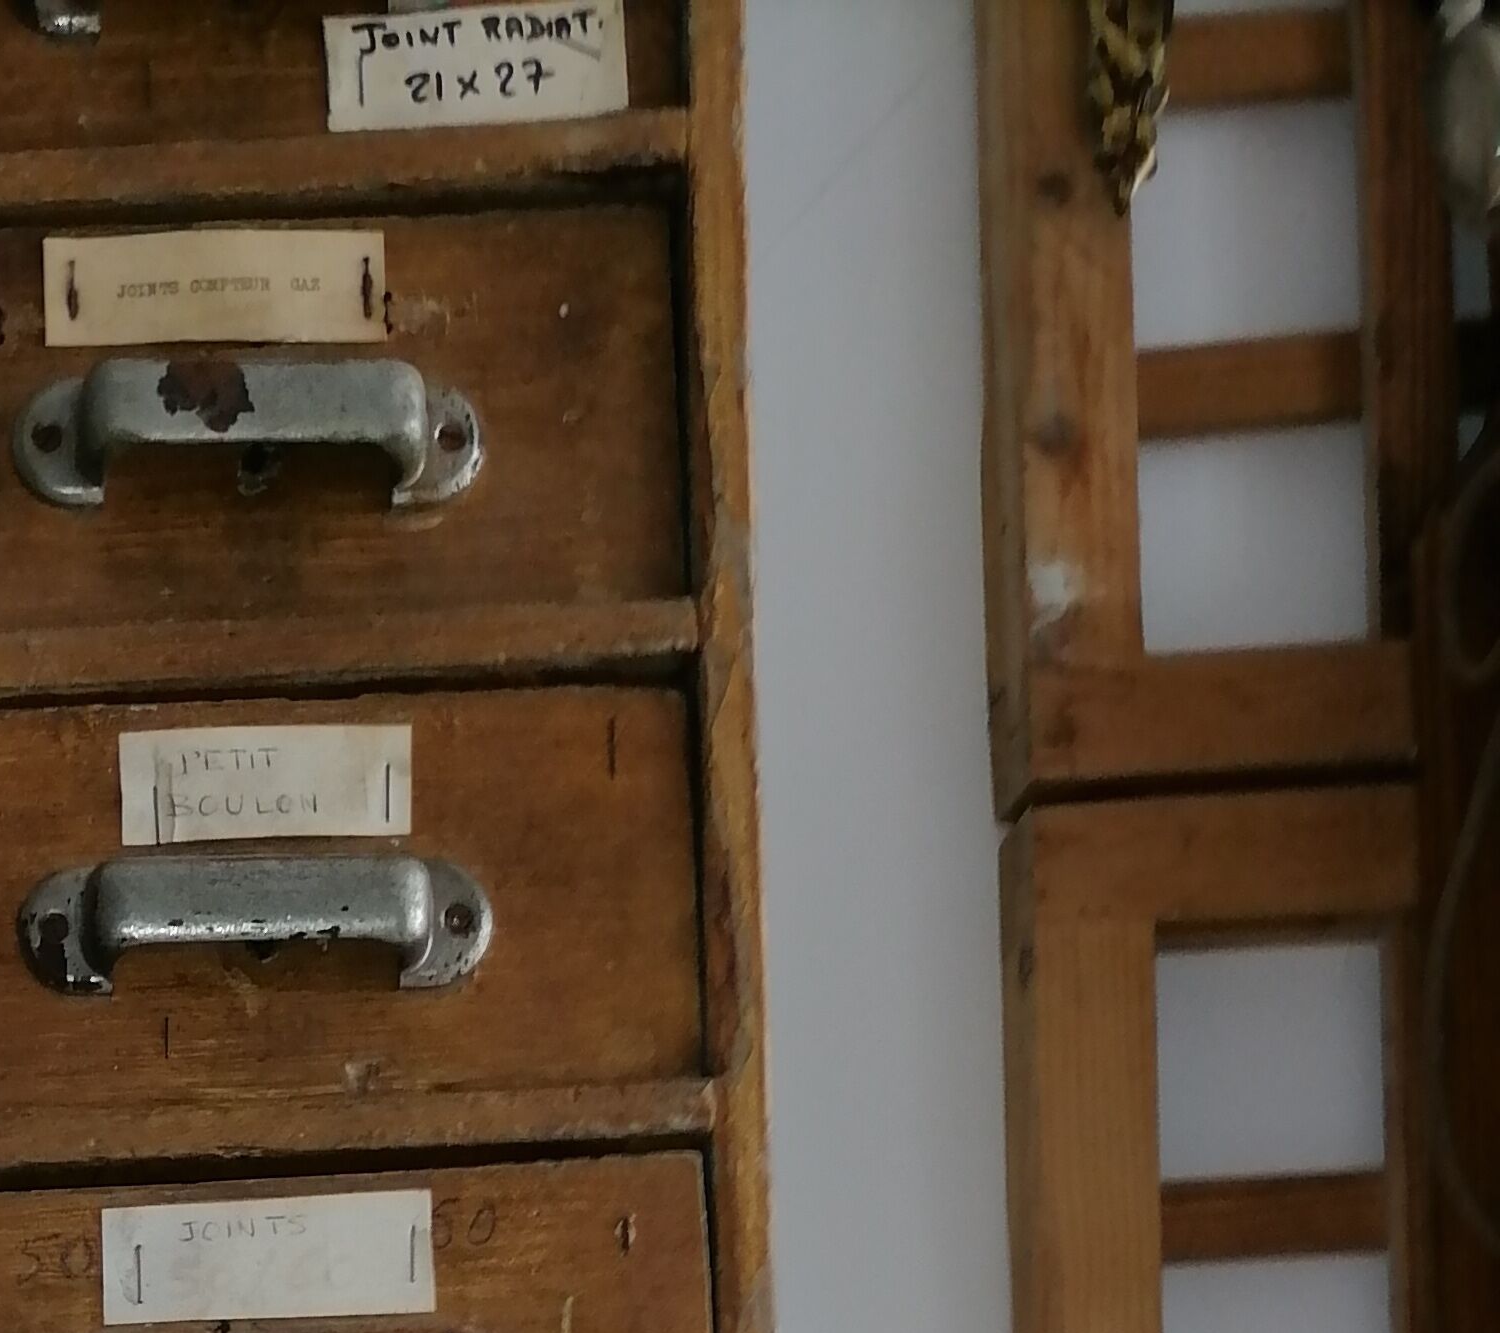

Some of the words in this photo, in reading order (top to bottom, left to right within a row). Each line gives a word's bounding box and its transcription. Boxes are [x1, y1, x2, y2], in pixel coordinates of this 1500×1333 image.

[351, 19, 462, 54] JOINT
[405, 71, 443, 103] 21
[494, 57, 554, 99] 27
[116, 281, 181, 299] JOINTS
[189, 276, 273, 294] COMPTEUR
[289, 274, 323, 293] GAZ
[167, 793, 318, 818] BOULON
[177, 1214, 309, 1243] JOINTS
